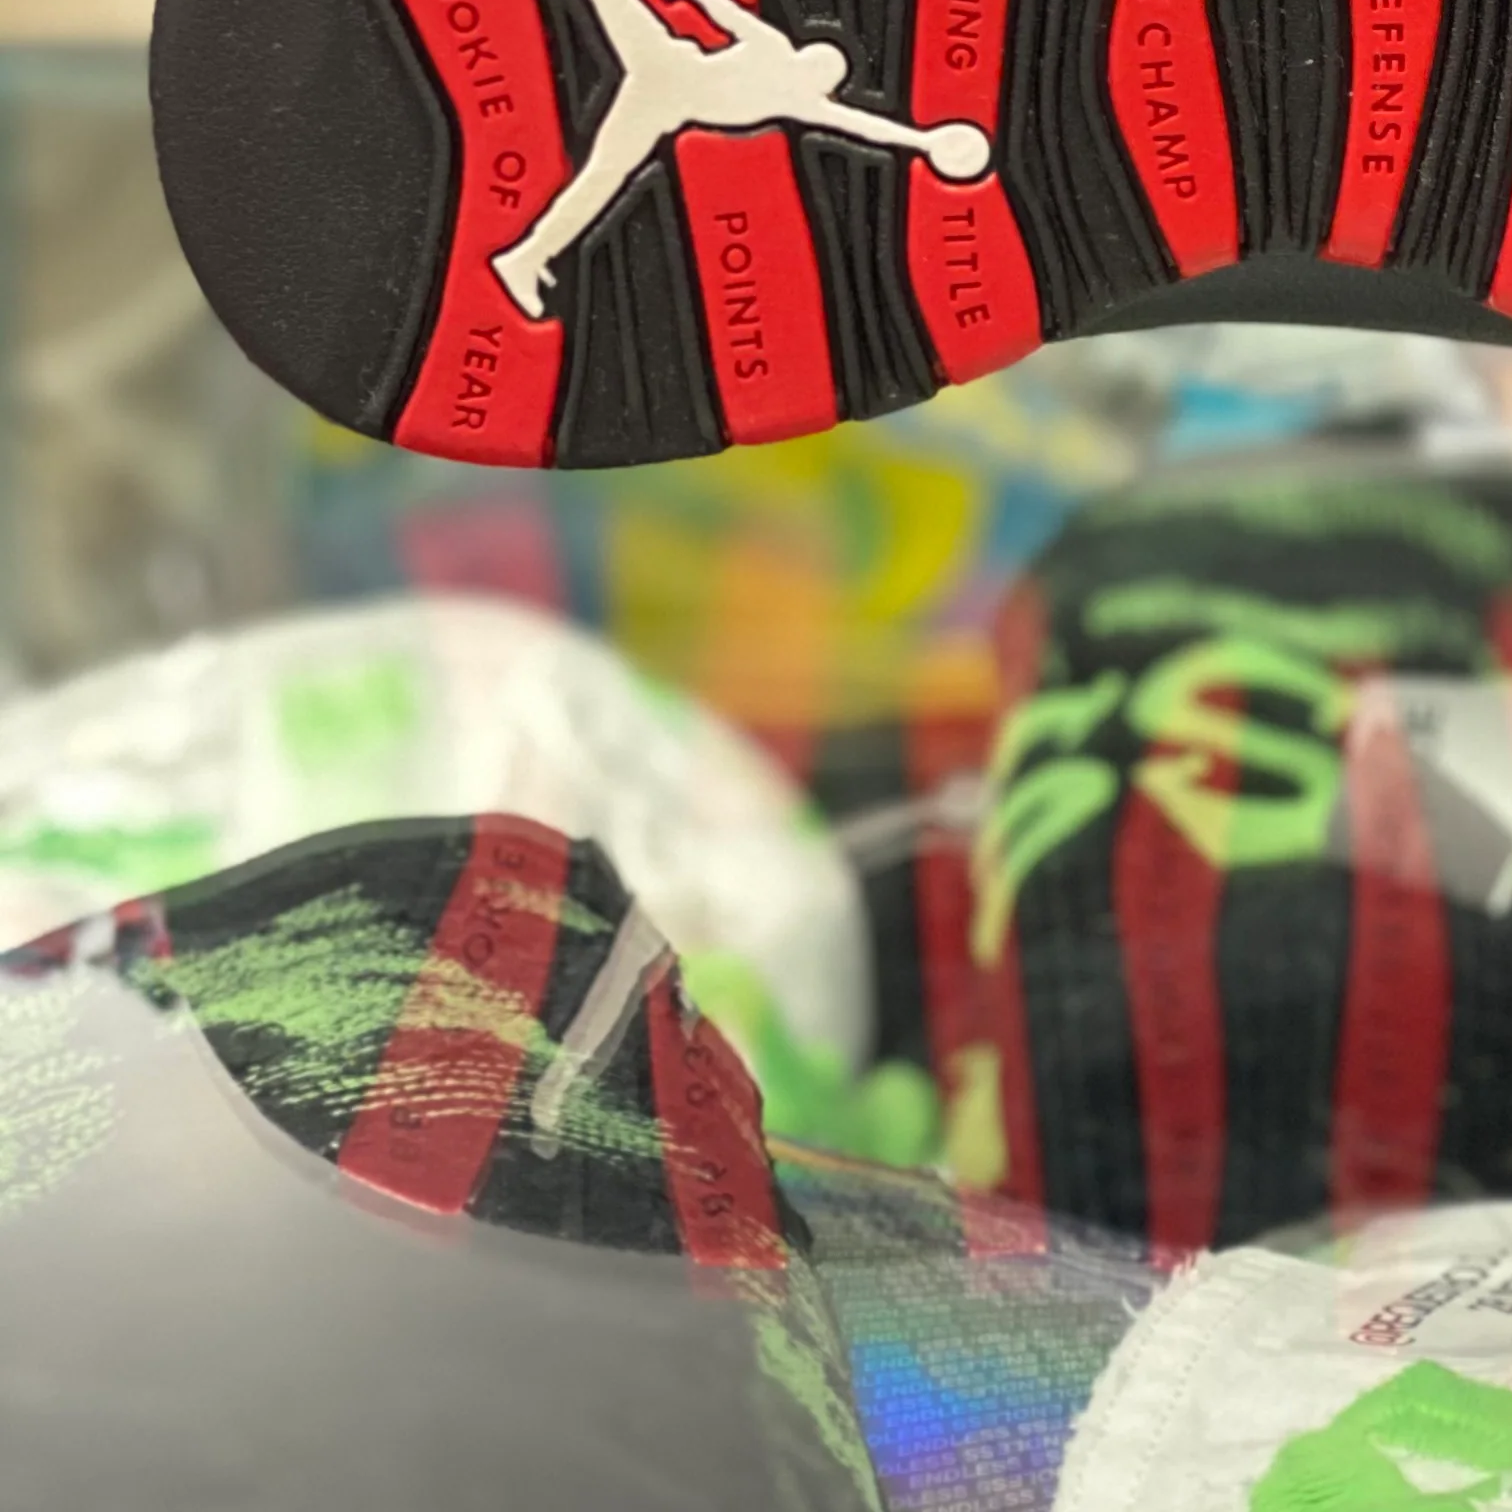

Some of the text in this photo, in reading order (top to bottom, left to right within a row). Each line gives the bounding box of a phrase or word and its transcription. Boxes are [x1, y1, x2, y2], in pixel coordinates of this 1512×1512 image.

[1136, 21, 1198, 200] CHAMP
[488, 149, 528, 211] OF
[713, 209, 771, 382] POINTS
[942, 207, 991, 331] TITLE
[452, 323, 504, 432] YEAR
